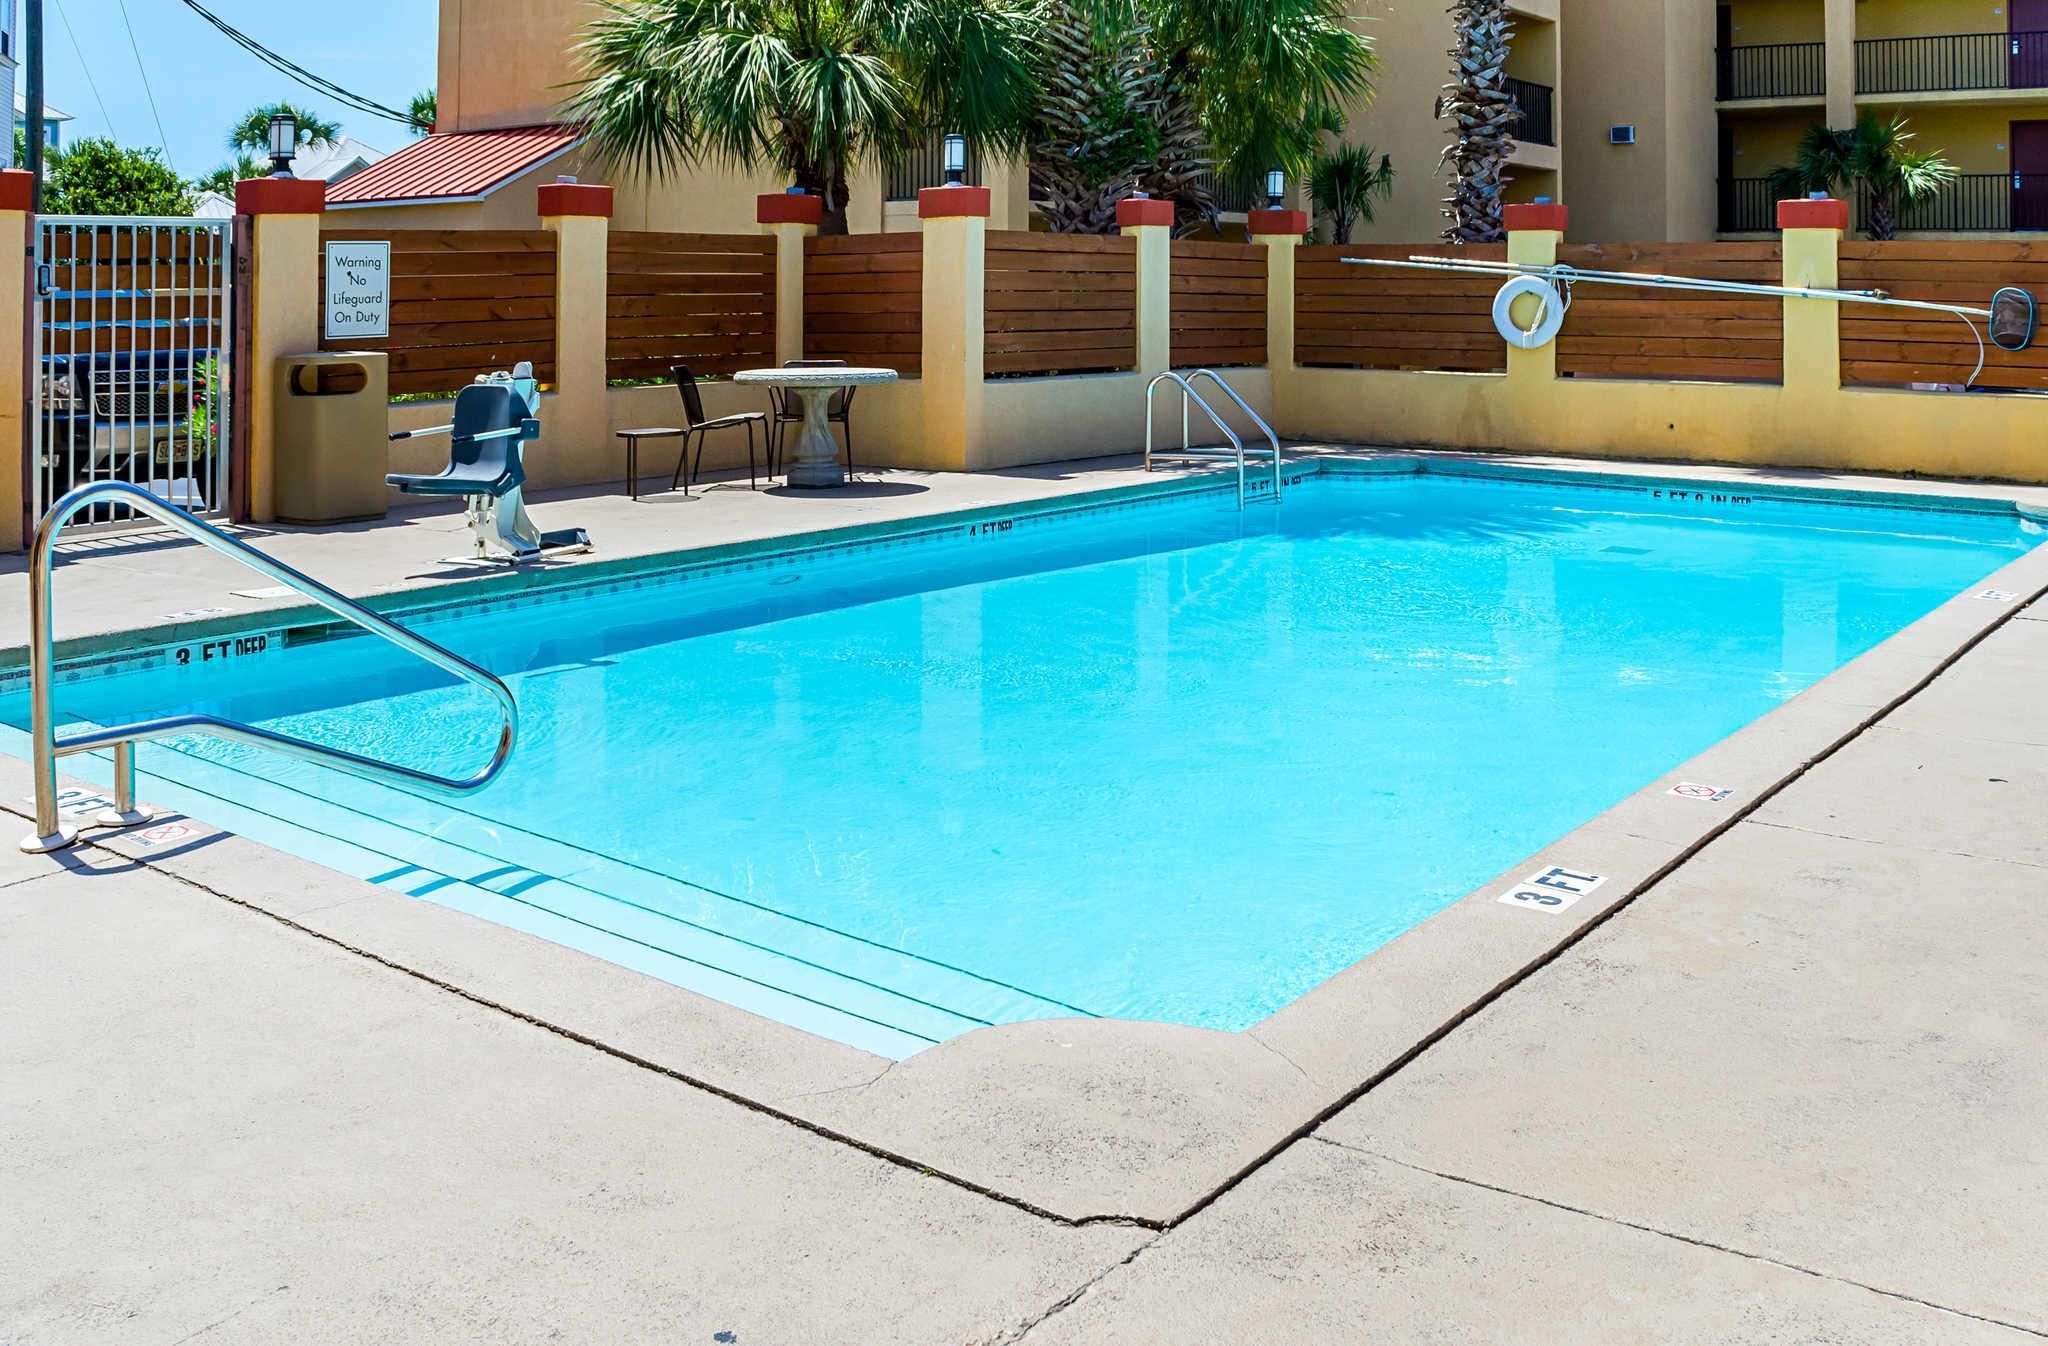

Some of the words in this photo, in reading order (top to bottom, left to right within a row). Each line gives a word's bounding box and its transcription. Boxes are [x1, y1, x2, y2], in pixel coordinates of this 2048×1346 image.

[335, 256, 382, 270] Warning
[350, 275, 367, 286] No
[333, 291, 383, 307] Lifeguard
[335, 312, 351, 323] On
[356, 311, 380, 325] Duty
[982, 521, 997, 534] FT
[175, 647, 190, 666] 3
[203, 640, 232, 661] FT
[235, 635, 267, 656] DEEP
[1514, 891, 1563, 906] 3
